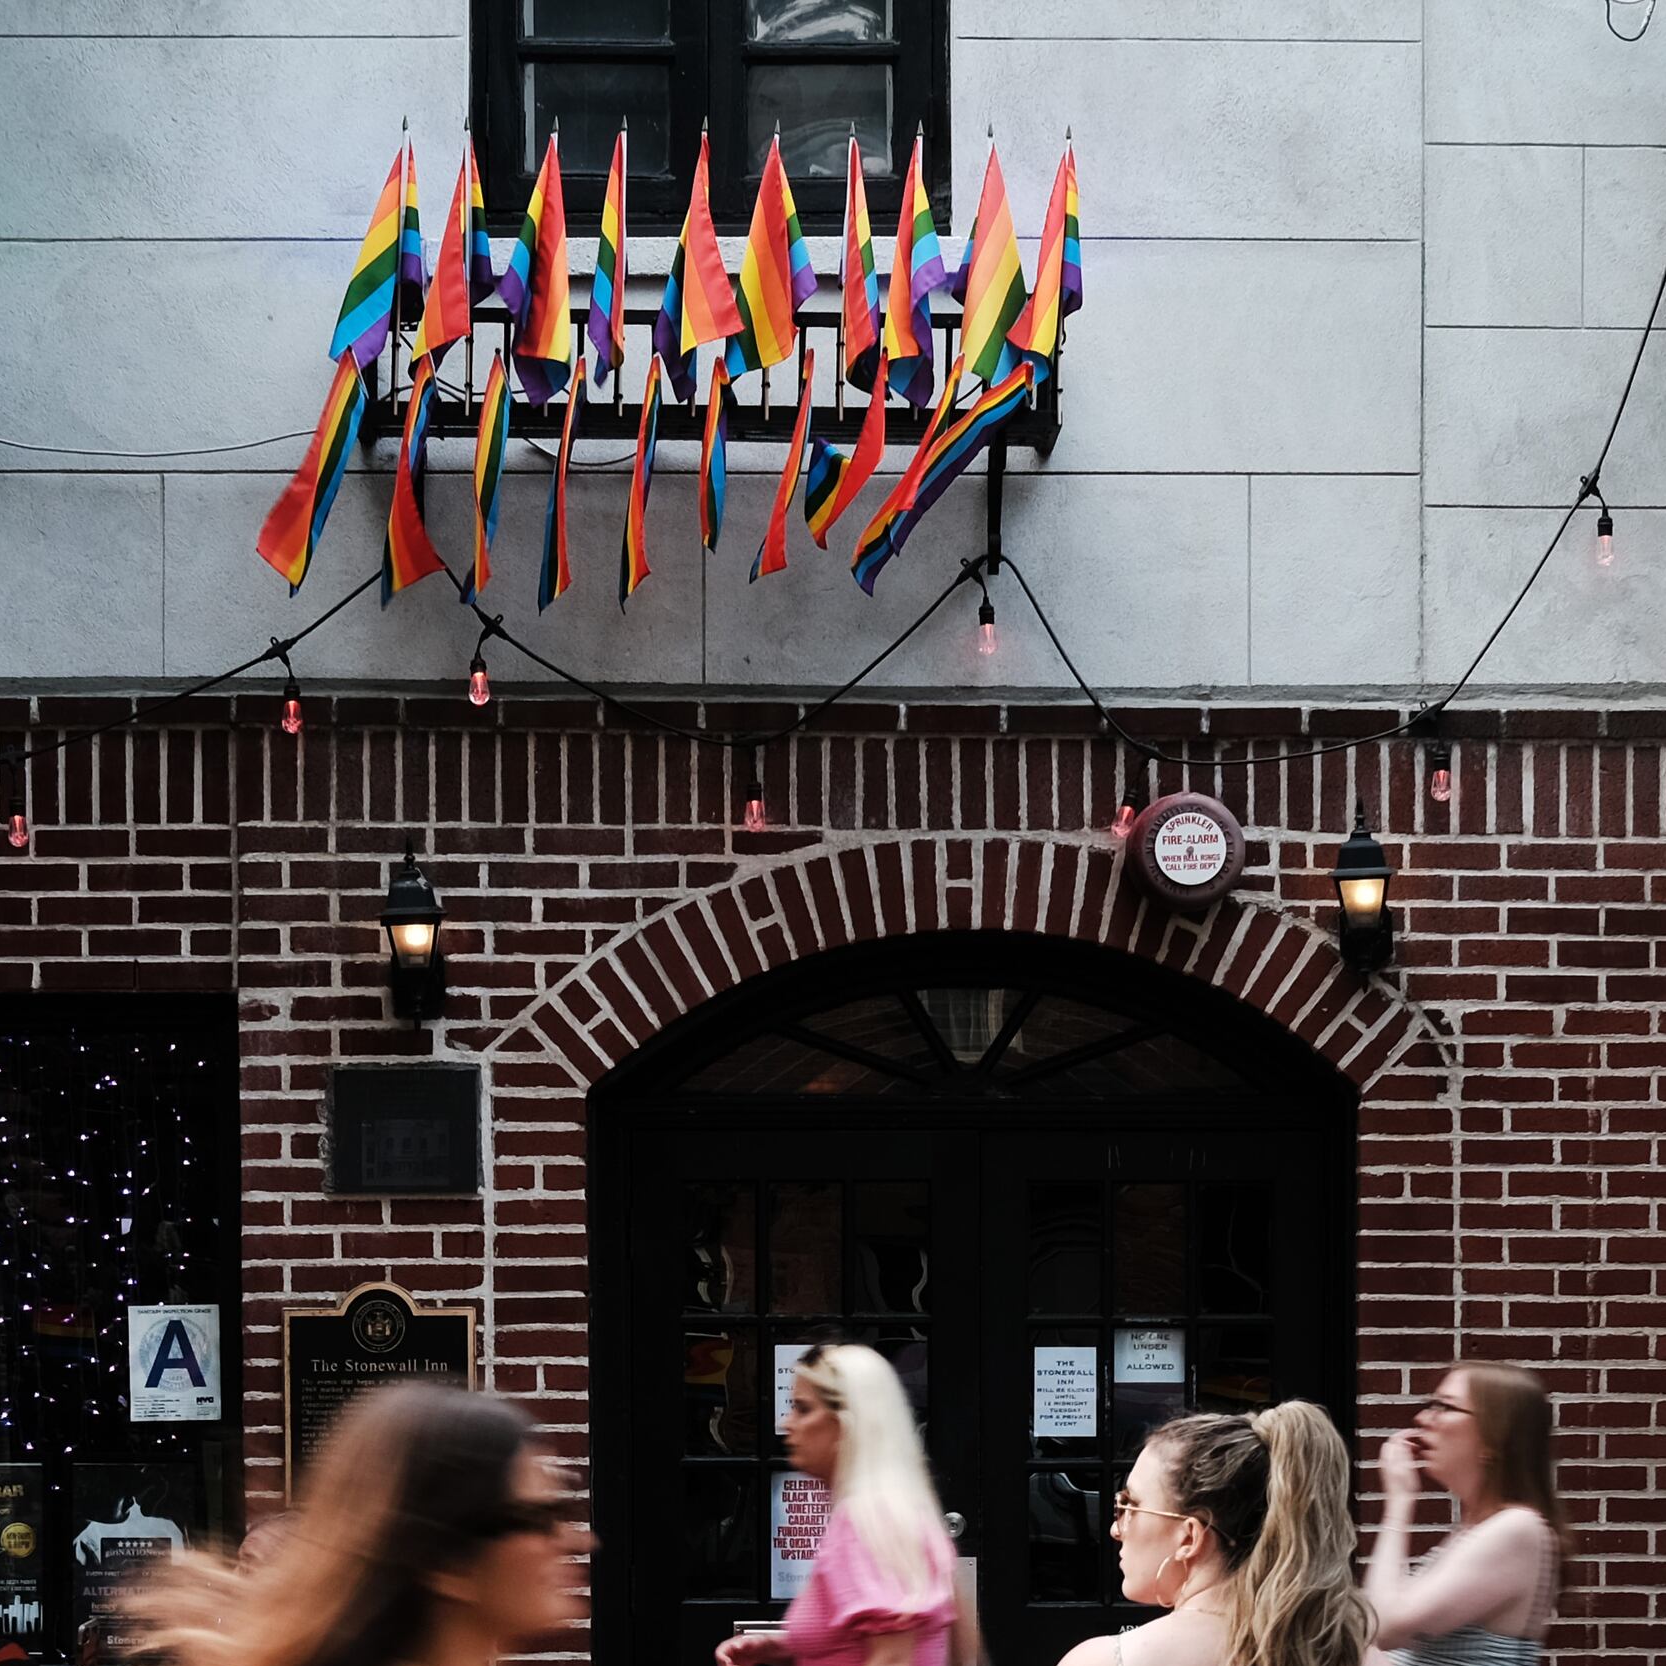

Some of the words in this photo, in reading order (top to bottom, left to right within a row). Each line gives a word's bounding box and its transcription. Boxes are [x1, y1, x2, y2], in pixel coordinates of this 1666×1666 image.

[1165, 816, 1213, 832] SPRINKLER
[1162, 835, 1218, 845] FIRE-ALARM
[145, 1320, 207, 1388] A
[311, 1360, 338, 1372] The
[344, 1359, 417, 1372] Stonewall
[425, 1359, 448, 1372] Inn
[782, 1492, 808, 1502] BLACK
[789, 1515, 825, 1525] CABARET
[773, 1538, 787, 1548] THE
[789, 1538, 811, 1548] OKRA
